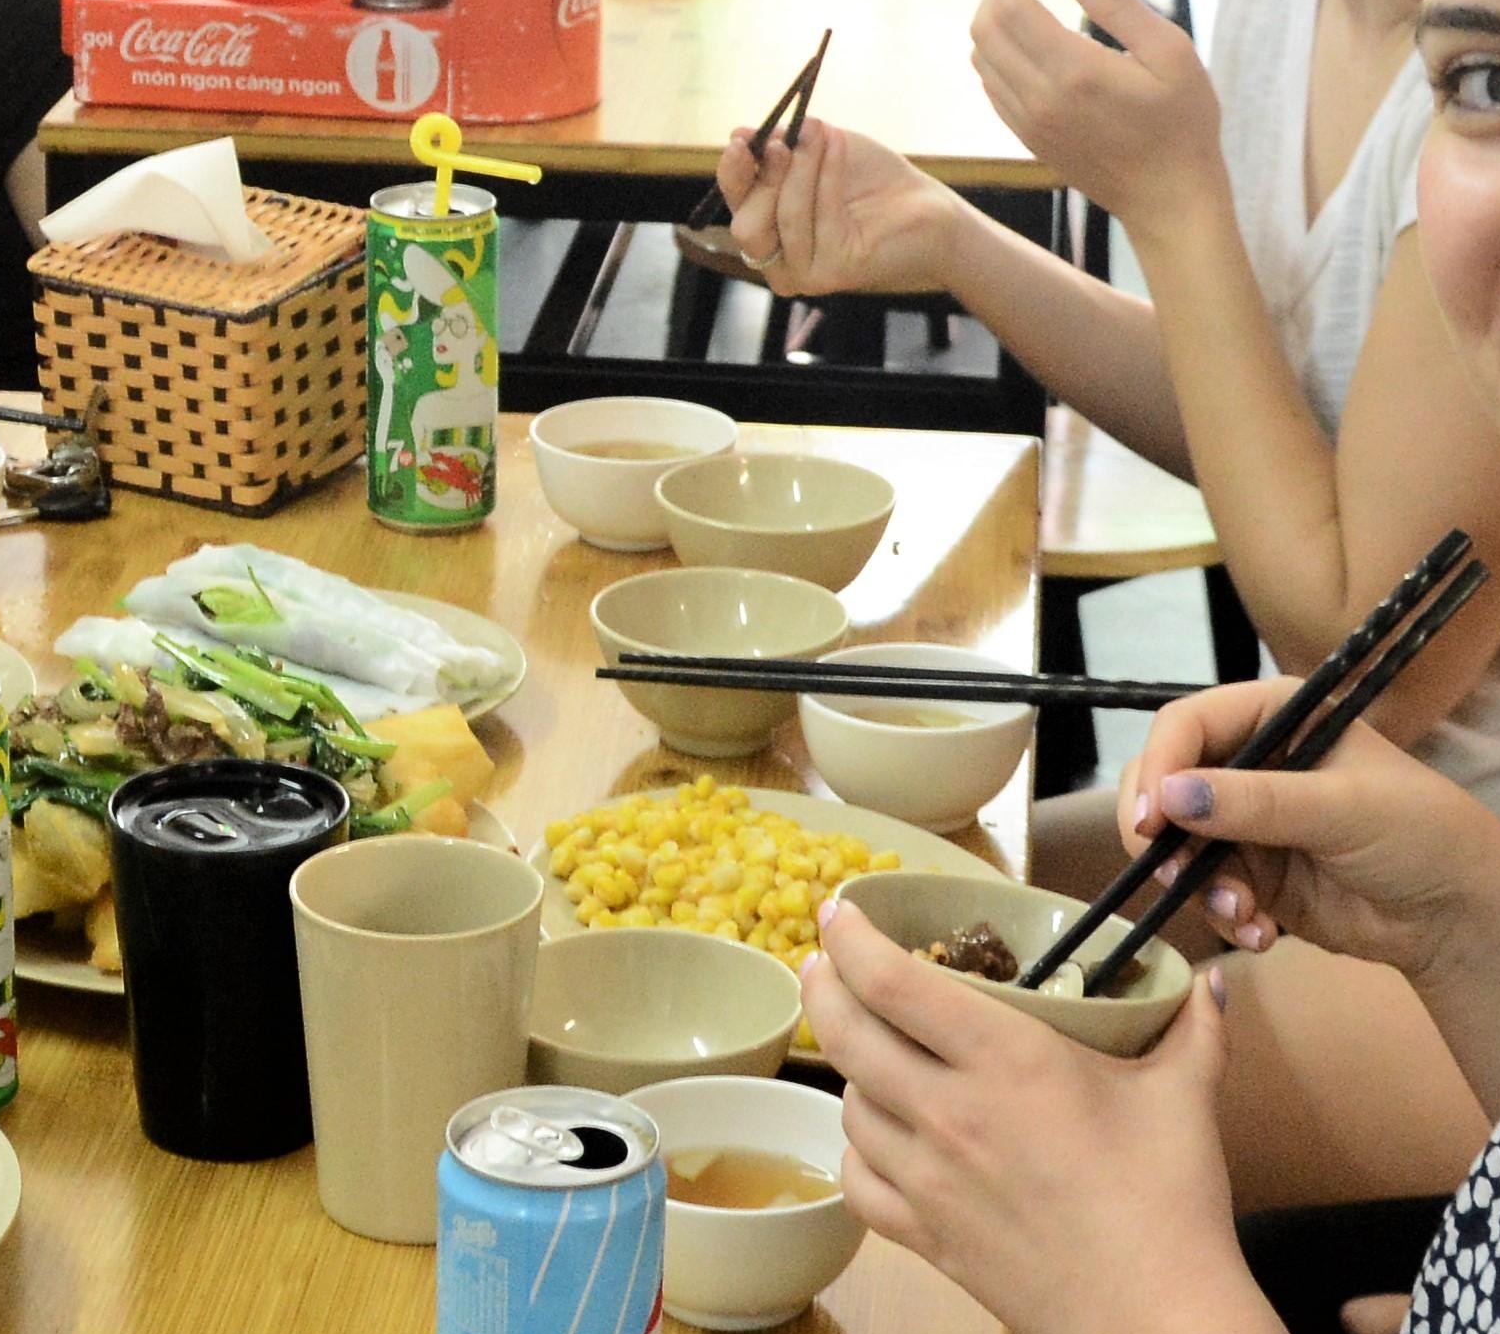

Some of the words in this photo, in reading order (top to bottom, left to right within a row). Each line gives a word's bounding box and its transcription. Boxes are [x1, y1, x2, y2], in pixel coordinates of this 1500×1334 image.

[119, 17, 259, 67] Coca-Cola
[180, 71, 232, 92] ngon
[288, 78, 342, 98] ngon
